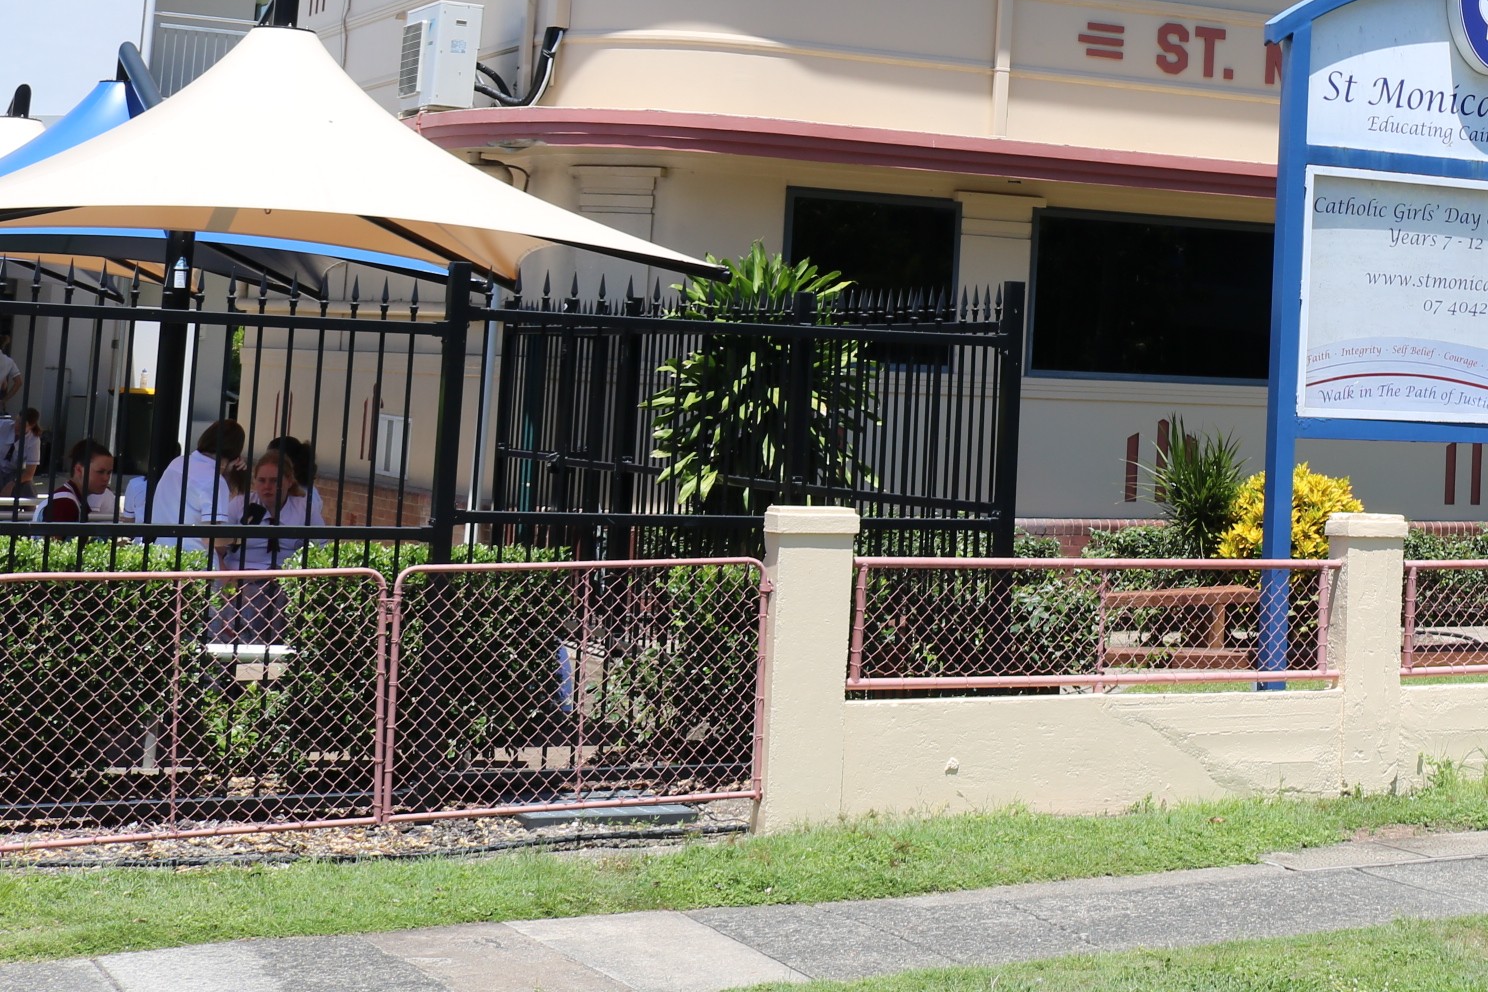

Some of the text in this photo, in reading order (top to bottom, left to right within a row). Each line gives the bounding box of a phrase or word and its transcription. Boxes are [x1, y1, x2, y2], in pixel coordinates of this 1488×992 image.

[1156, 22, 1234, 75] ST.
[1323, 70, 1356, 102] St
[1367, 115, 1453, 144] Educating
[1313, 196, 1387, 218] Catholic
[1394, 203, 1440, 224] Girls'
[1444, 207, 1480, 231] Day
[1389, 228, 1437, 247] Years
[1443, 236, 1452, 250] 7
[1468, 238, 1483, 251] 12
[1423, 299, 1442, 314] 07
[1447, 301, 1487, 316] 4042
[1307, 351, 1330, 365] Faith
[1341, 344, 1382, 359] Integrity
[1392, 345, 1408, 356] Self
[1410, 346, 1434, 358] Belief
[1444, 351, 1478, 368] Courage
[1319, 387, 1355, 404] Walk
[1359, 386, 1372, 398] in
[1377, 384, 1400, 398] The
[1406, 385, 1436, 401] Path
[1441, 388, 1453, 405] of
